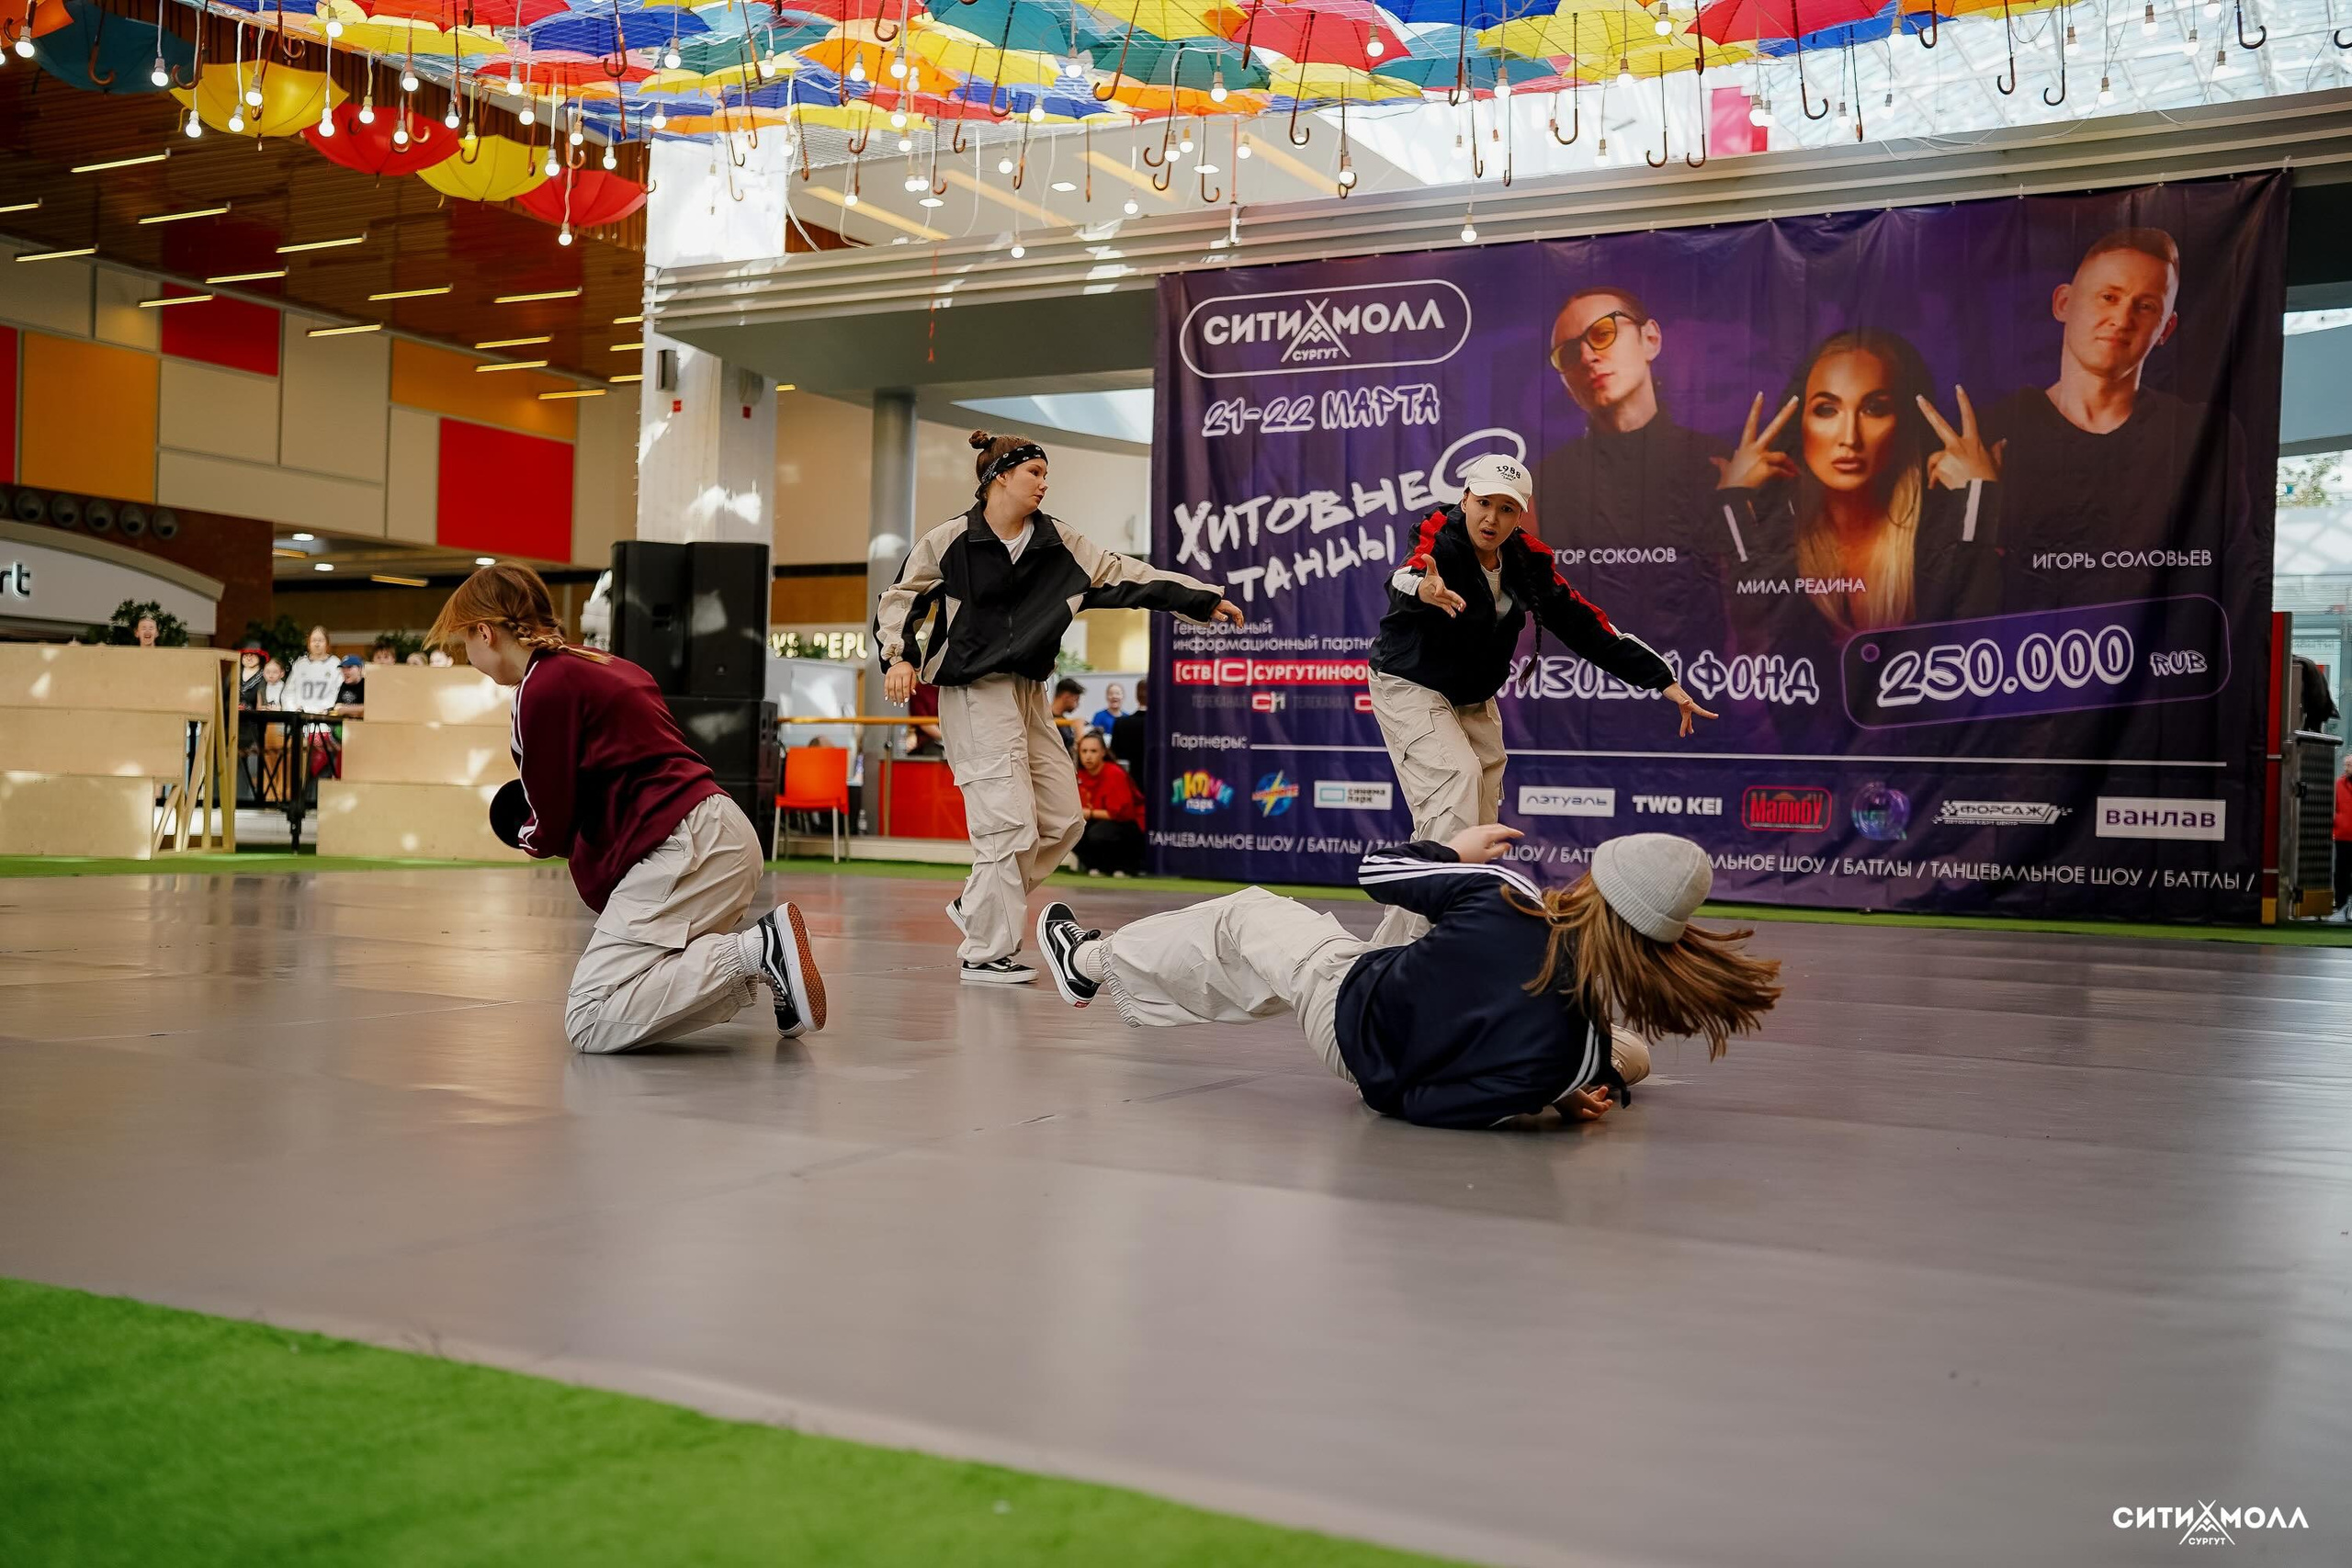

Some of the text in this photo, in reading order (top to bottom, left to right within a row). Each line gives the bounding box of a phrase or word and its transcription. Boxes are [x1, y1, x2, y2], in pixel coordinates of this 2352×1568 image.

[1204, 299, 1445, 345] СИТИ МОЛЛ
[1293, 347, 1338, 362] СУРГУТ
[1202, 382, 1440, 436] 21-22 МАРТА
[1227, 525, 1395, 601] ТАНЦЫ
[1589, 547, 1677, 564] СОКОЛОВ
[2032, 549, 2212, 570] ИГОРЬ СОЛОВЬЕВ
[1736, 578, 1866, 595] МИЛА РЕДИНА
[1173, 635, 1318, 653] информационный
[1877, 624, 2209, 708] 250.000 RUB
[302, 681, 327, 700] 07
[1171, 732, 1248, 751] Партнеры:
[1632, 795, 1723, 816] TWO KEI
[1960, 805, 2044, 817] ФОРСАЖ
[2106, 807, 2216, 829] ванлав
[1148, 830, 1254, 851] ТАНЦЕВАЛЬНОЕ
[1256, 835, 1294, 852] ШОУ
[1307, 837, 1363, 855] БАТТЛЫ
[1502, 844, 1544, 863] ШОУ
[1780, 855, 1826, 874] ШОУ
[1843, 858, 1912, 878] БАТТЛЫ
[1930, 861, 2086, 886] ТАНЦЕВАЛЬНОЕ
[2090, 867, 2143, 887] ШОУ
[2164, 870, 2240, 890] БАТТЛЫ
